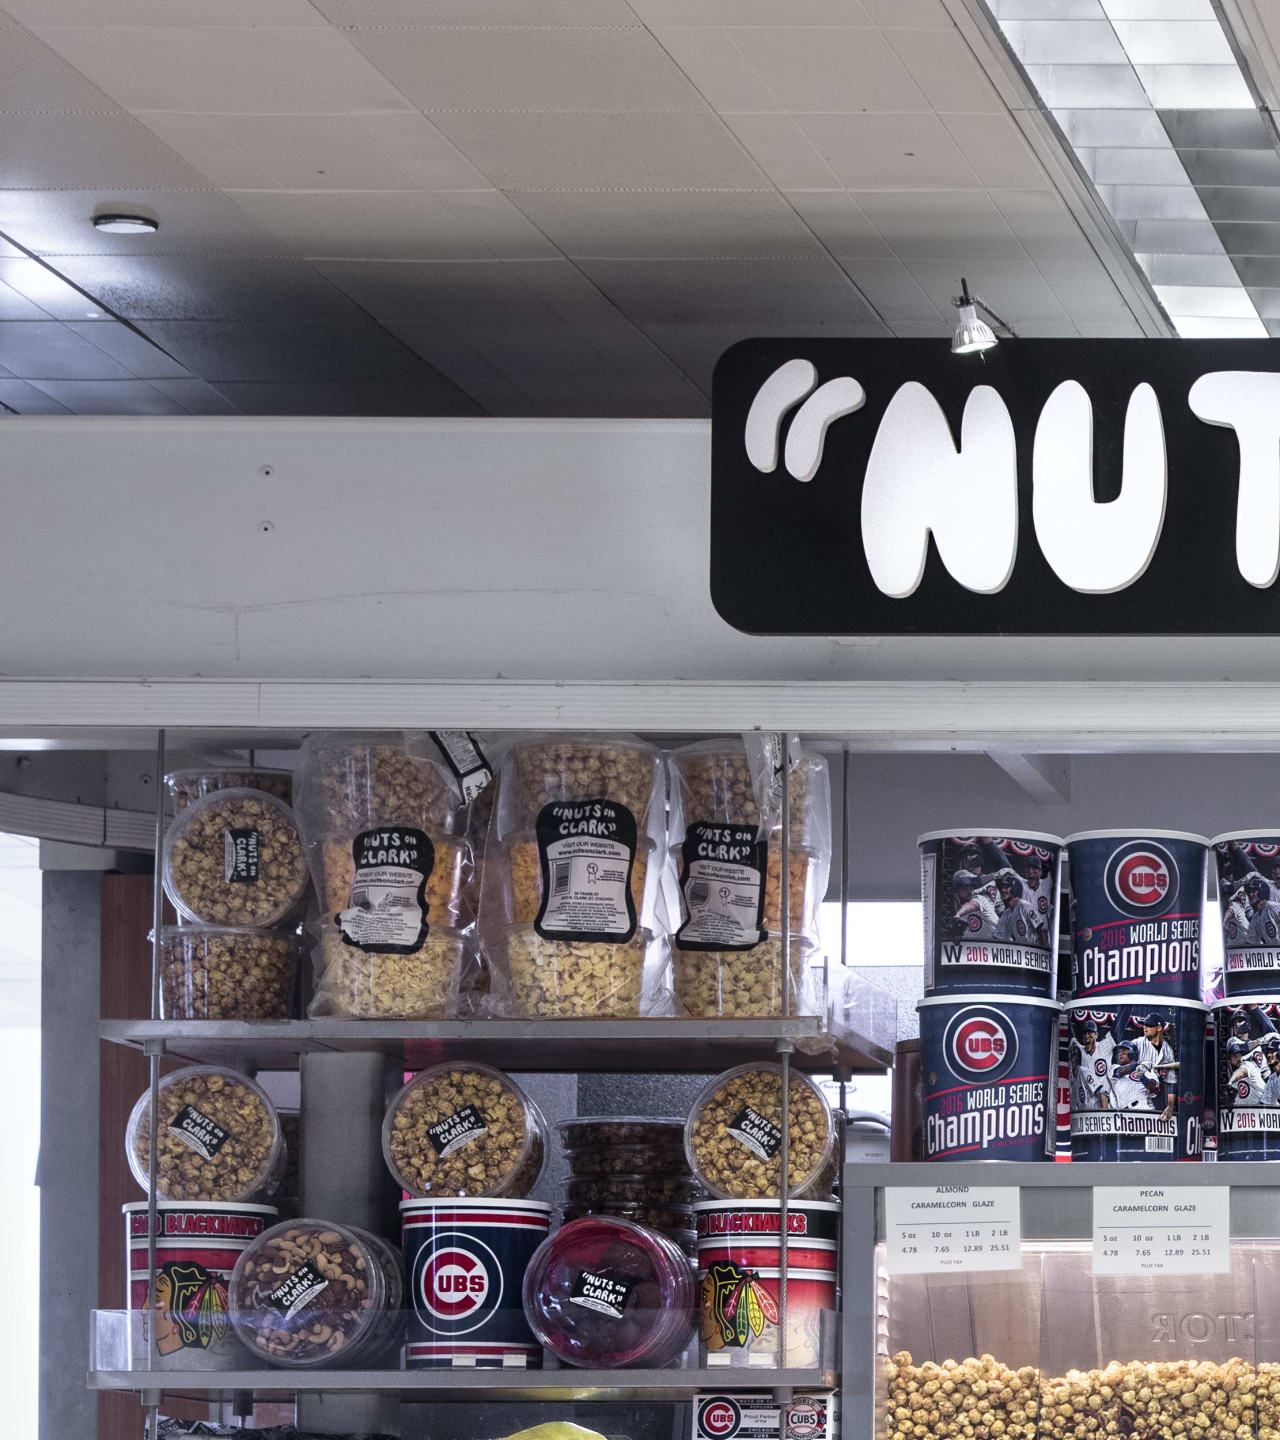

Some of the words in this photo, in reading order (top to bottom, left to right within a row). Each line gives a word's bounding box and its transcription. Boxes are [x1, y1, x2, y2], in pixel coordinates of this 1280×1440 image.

[553, 804, 601, 819] "NUTS
[604, 808, 615, 818] ON
[559, 819, 617, 835] CLARK"
[236, 838, 247, 876] CLARK"
[247, 832, 258, 864] "NUTS
[250, 865, 256, 876] ON
[1118, 855, 1168, 904] CUBS
[1101, 930, 1126, 947] 2016
[1129, 925, 1167, 944] WORLD
[1171, 919, 1199, 939] SERIES
[944, 945, 963, 963] W
[966, 945, 988, 962] 2016
[991, 947, 1022, 965] WORLD
[1025, 950, 1049, 969] SERIES
[1084, 940, 1200, 988] Champions
[955, 1020, 1004, 1069] CUBS
[940, 1094, 963, 1114] 2016
[967, 1087, 1006, 1106] WORLD
[1009, 1083, 1043, 1103] SERIES
[429, 1114, 461, 1136] "NUTS
[461, 1109, 472, 1117] ON
[439, 1115, 476, 1144] CLARK"
[927, 1103, 1043, 1155] Champions
[1114, 1114, 1175, 1135] Champions
[1221, 1113, 1233, 1130] W
[1236, 1113, 1256, 1128] 2016
[936, 1186, 969, 1194] ALMOND
[911, 1201, 967, 1209] CARAMELCORN
[973, 1200, 994, 1208] GLAZE
[271, 1274, 299, 1301] "NUTS
[298, 1266, 309, 1276] ON
[281, 1273, 314, 1306] CLARK"
[423, 1251, 485, 1315] CUBS
[582, 1272, 613, 1290] "NUTS
[615, 1284, 626, 1292] ON
[582, 1285, 623, 1303] CLARK"
[705, 1402, 734, 1434] CUBS
[791, 1413, 815, 1425] CUBS
